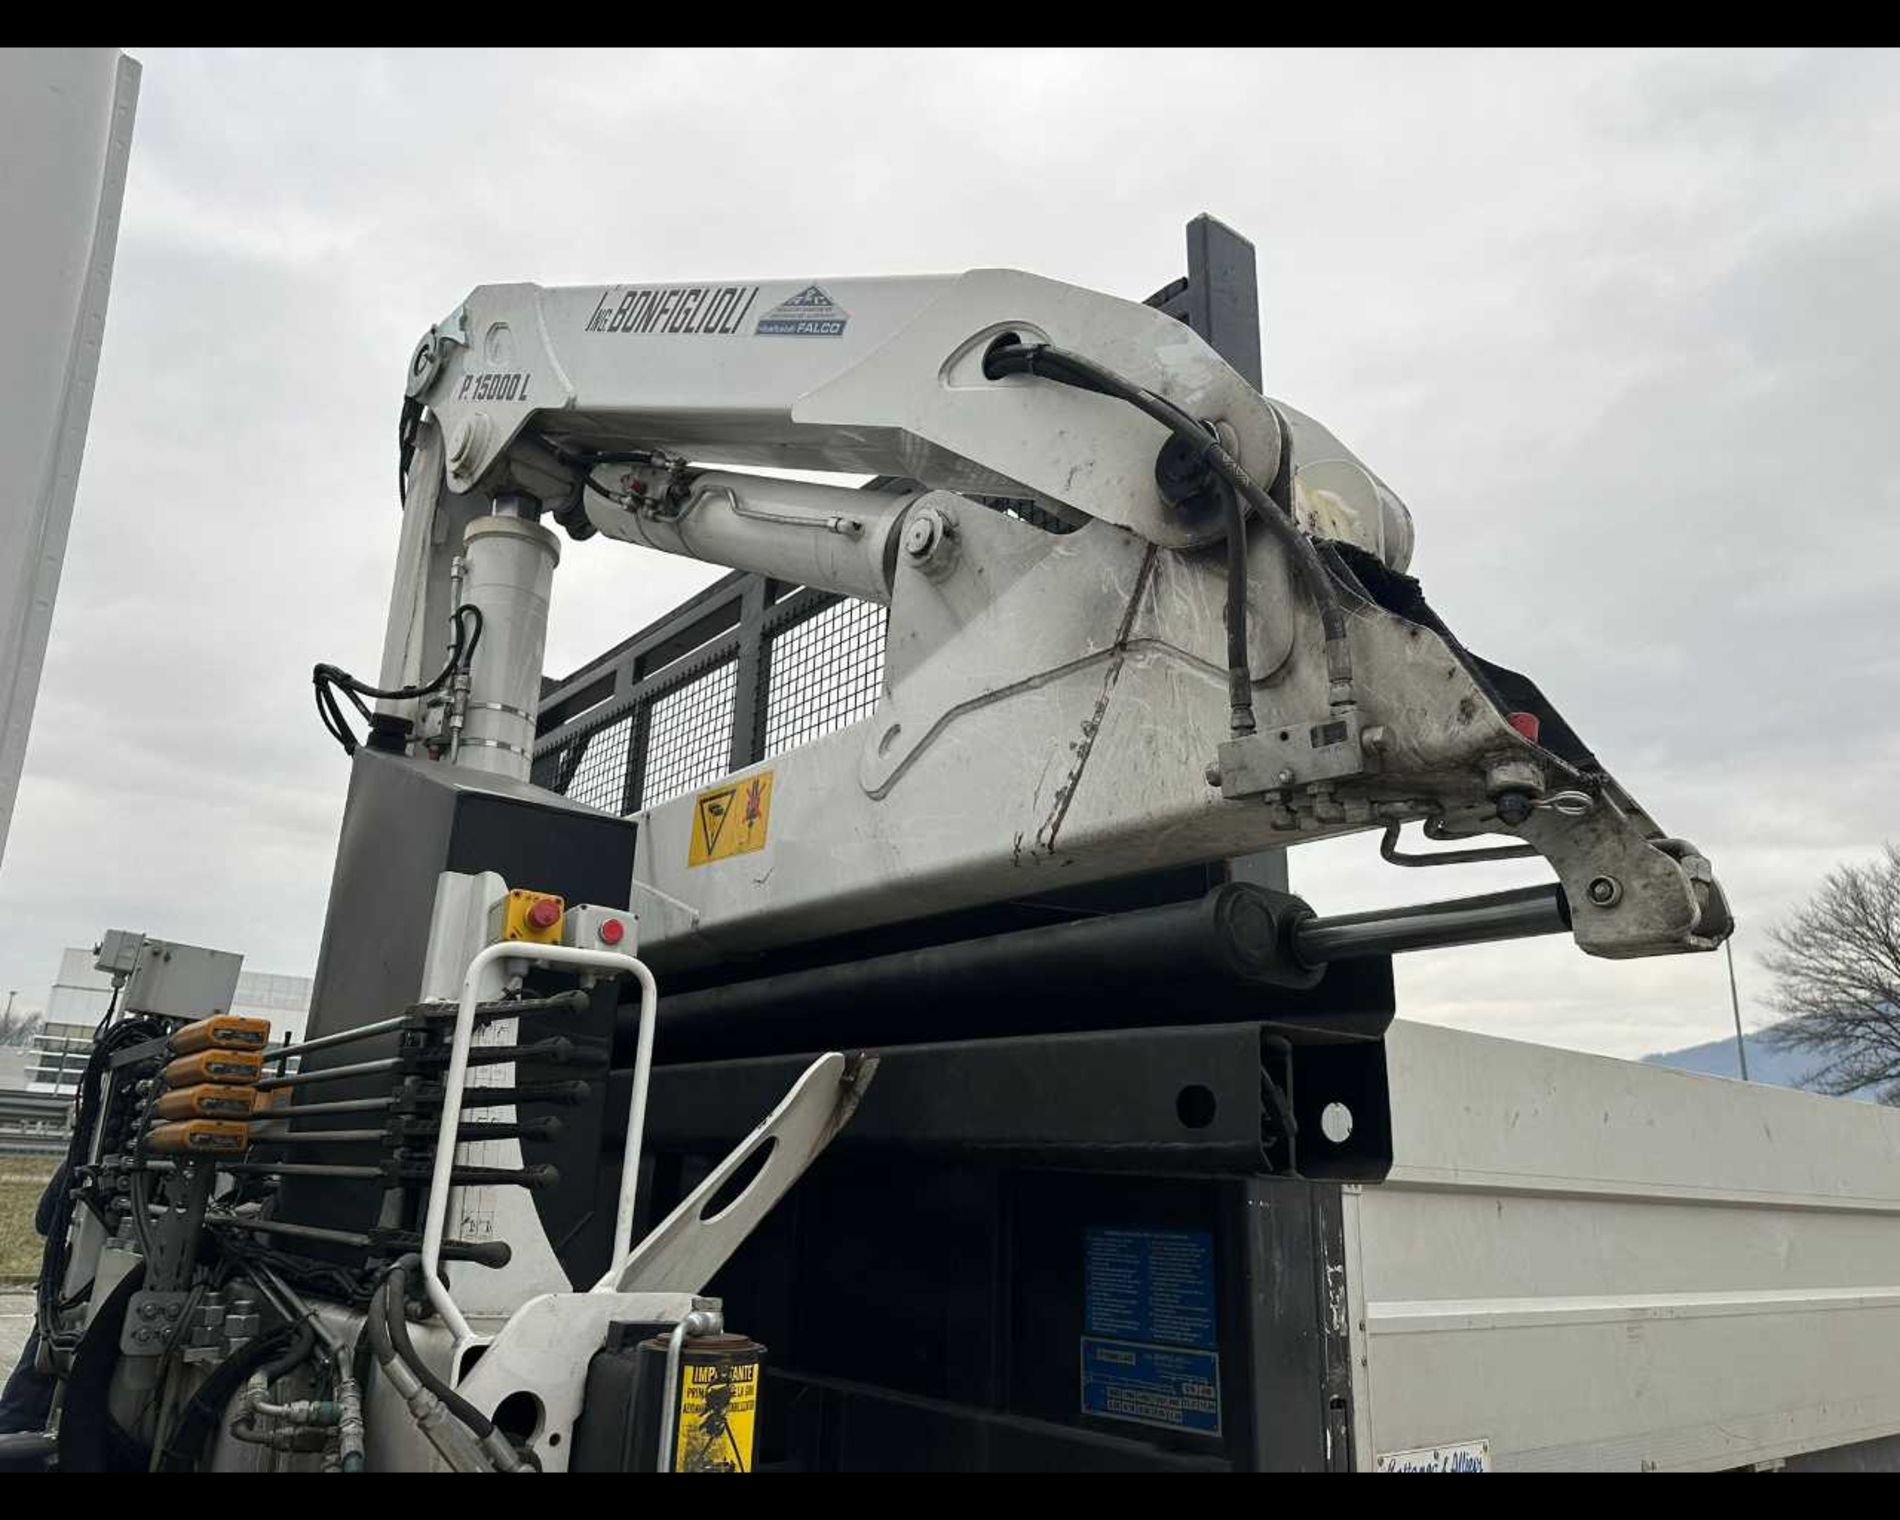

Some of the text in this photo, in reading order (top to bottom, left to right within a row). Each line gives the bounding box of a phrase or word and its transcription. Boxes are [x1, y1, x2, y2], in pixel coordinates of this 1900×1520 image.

[606, 286, 760, 335] BONFIGLIOLI
[796, 322, 841, 334] FALCO
[472, 373, 522, 401] 15000
[518, 373, 531, 401] L
[692, 1364, 754, 1383] IMPTANTE
